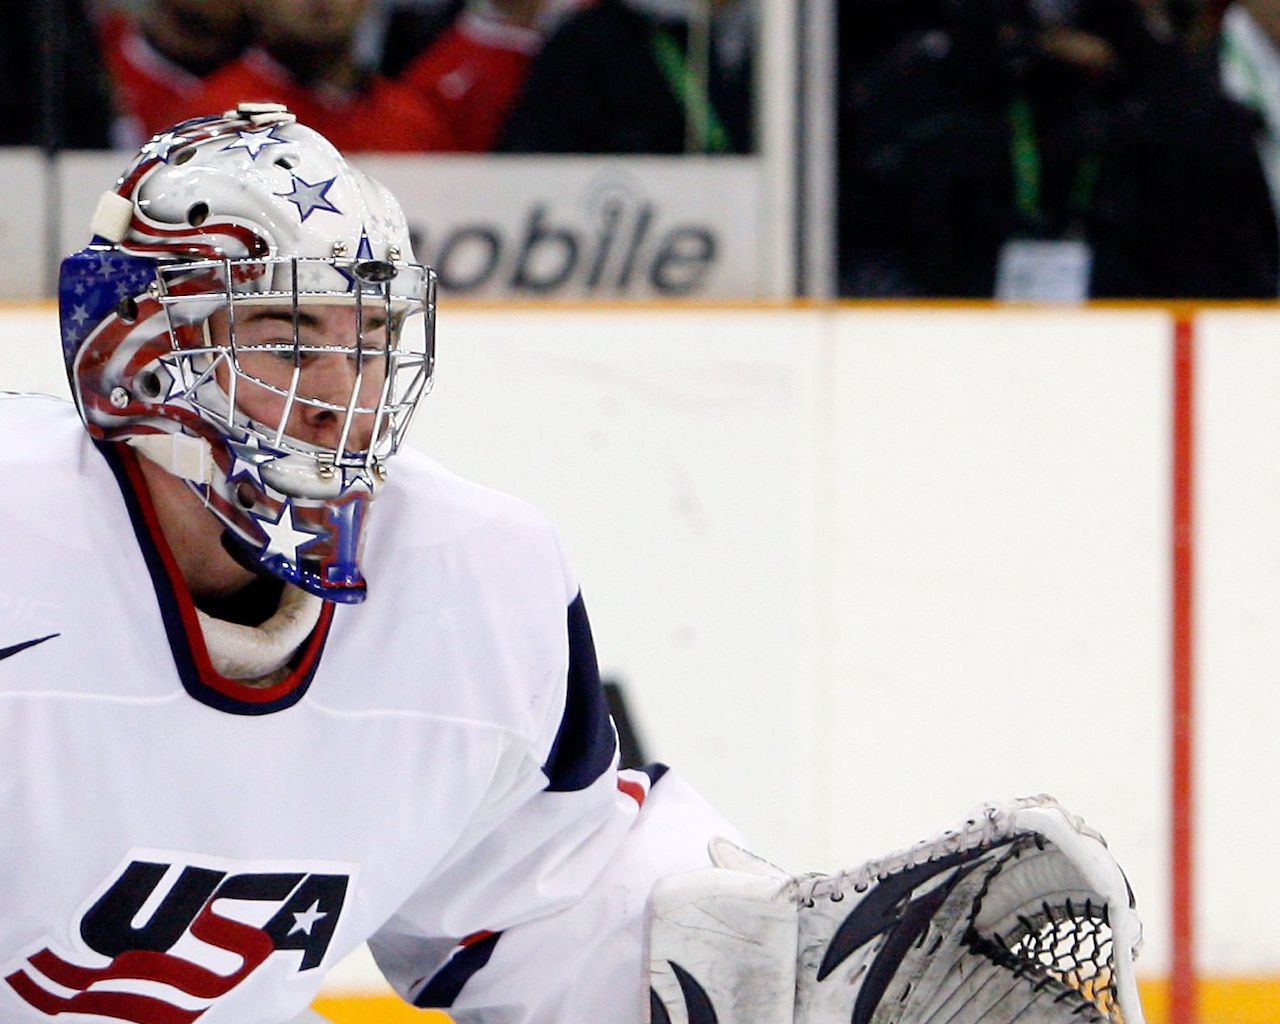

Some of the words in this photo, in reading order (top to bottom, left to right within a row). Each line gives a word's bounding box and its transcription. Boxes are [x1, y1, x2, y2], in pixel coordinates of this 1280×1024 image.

[410, 198, 717, 292] obile
[322, 491, 368, 588] 1
[79, 860, 350, 999] USA
